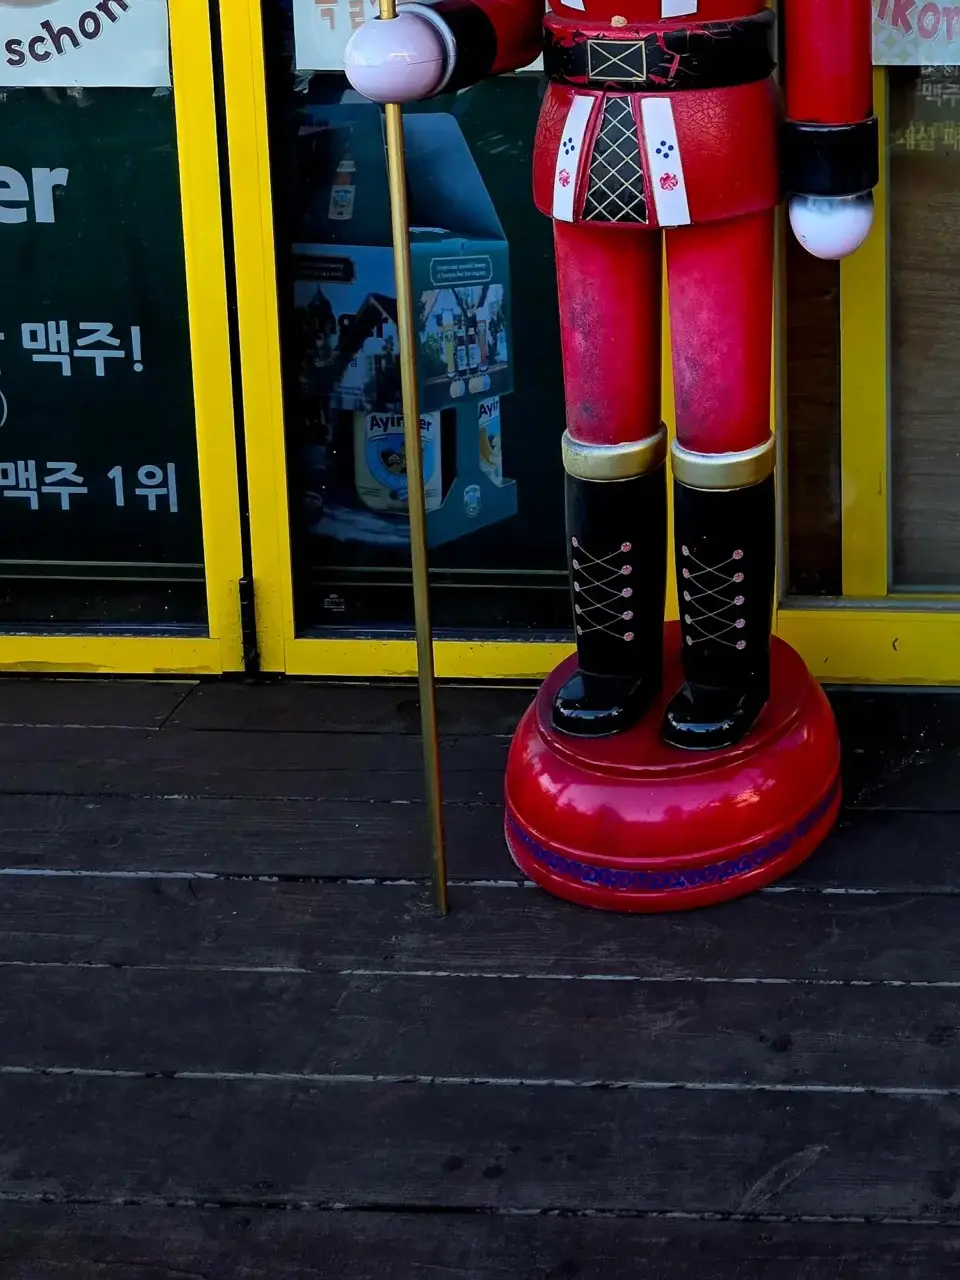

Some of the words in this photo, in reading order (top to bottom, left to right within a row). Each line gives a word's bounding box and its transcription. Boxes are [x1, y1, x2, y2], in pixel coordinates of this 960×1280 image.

[21, 320, 144, 377] 맥주!
[370, 414, 433, 432] Ayiner
[107, 462, 179, 513] 1위
